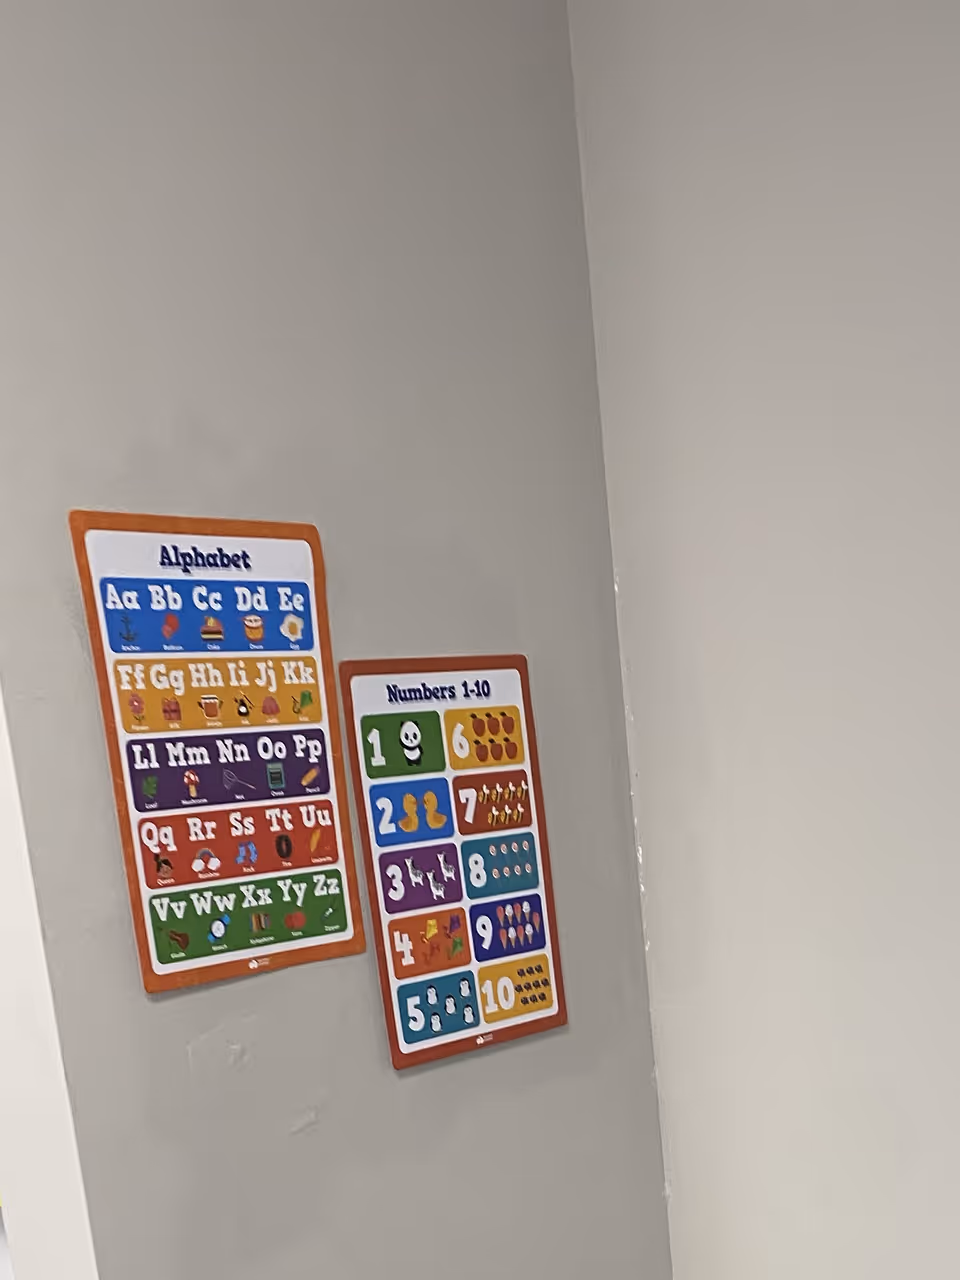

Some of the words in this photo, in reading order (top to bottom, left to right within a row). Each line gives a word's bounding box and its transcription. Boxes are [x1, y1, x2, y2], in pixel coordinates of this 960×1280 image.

[159, 544, 252, 573] Alphabet
[105, 583, 141, 610] Aa
[148, 584, 182, 610] Bb
[192, 585, 222, 611] Cc
[234, 586, 269, 611] Dd
[277, 586, 304, 611] Ee
[117, 663, 145, 690] Ff
[150, 663, 185, 696] Gg
[188, 661, 225, 689] Hh
[227, 660, 249, 686] Ii
[254, 659, 276, 693] Jj
[281, 660, 315, 685] Kk
[386, 682, 456, 703] Numbers
[461, 680, 491, 699] 1-10
[131, 742, 160, 770] Ll
[165, 741, 211, 767] Mm
[215, 739, 250, 764] Nn
[257, 736, 287, 760] Oo
[292, 734, 322, 763] Pp
[367, 728, 386, 767] 1
[452, 723, 470, 759] 6
[375, 797, 396, 835] 2
[458, 788, 477, 824] 7
[141, 821, 177, 854] Qq
[187, 817, 216, 841] Rr
[229, 812, 255, 837] Ss
[265, 808, 294, 832] Tt
[299, 805, 332, 828] Uu
[385, 864, 405, 901] 3
[468, 853, 487, 888] 8
[151, 897, 187, 921] Vv
[190, 891, 236, 915] Ww
[239, 885, 273, 908] Xx
[277, 879, 308, 907] Yy
[313, 874, 340, 897] Zz
[393, 930, 415, 966] 4
[475, 915, 493, 950] 9
[481, 976, 515, 1014] 10
[406, 995, 425, 1032] 5
